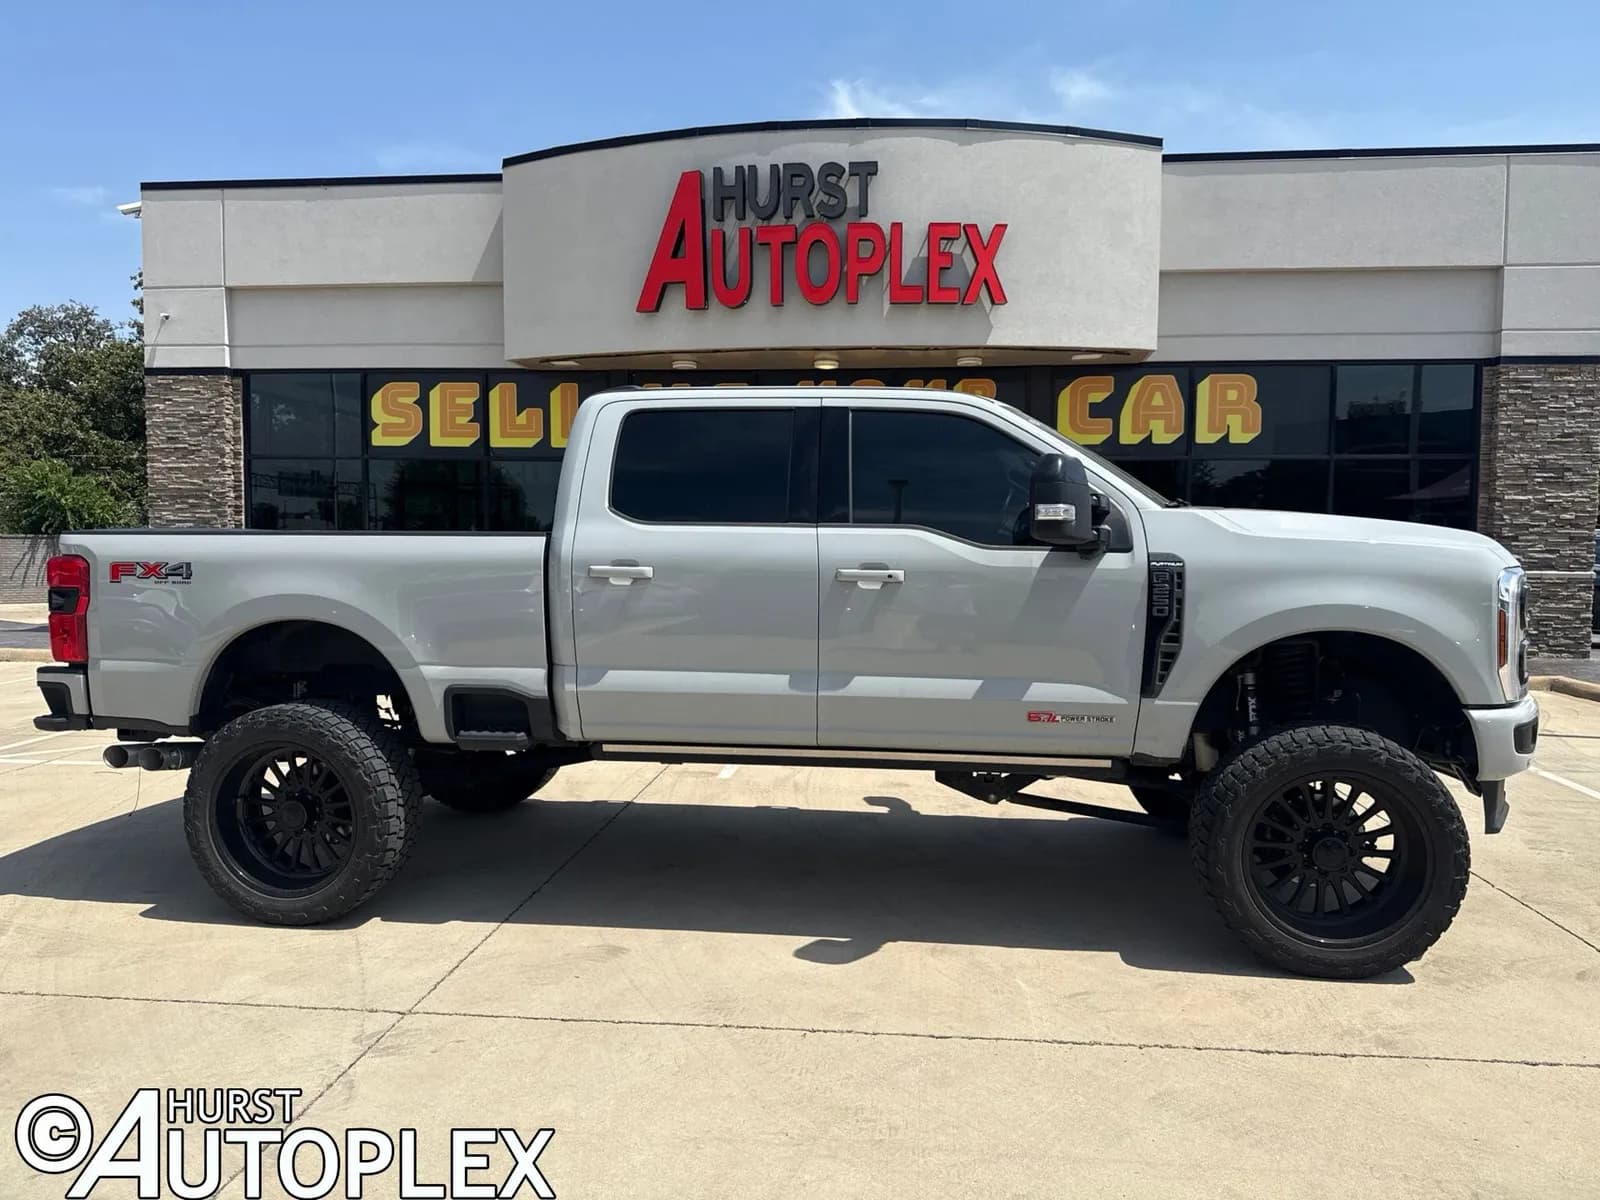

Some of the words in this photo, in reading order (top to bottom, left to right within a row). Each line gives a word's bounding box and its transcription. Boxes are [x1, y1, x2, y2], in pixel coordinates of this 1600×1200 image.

[713, 161, 878, 221] HURST
[636, 169, 1009, 313] AUTOPLEX
[1056, 374, 1263, 445] CAR
[109, 562, 192, 583] FX4
[1060, 715, 1085, 723] POWER
[1086, 715, 1114, 724] STROKE
